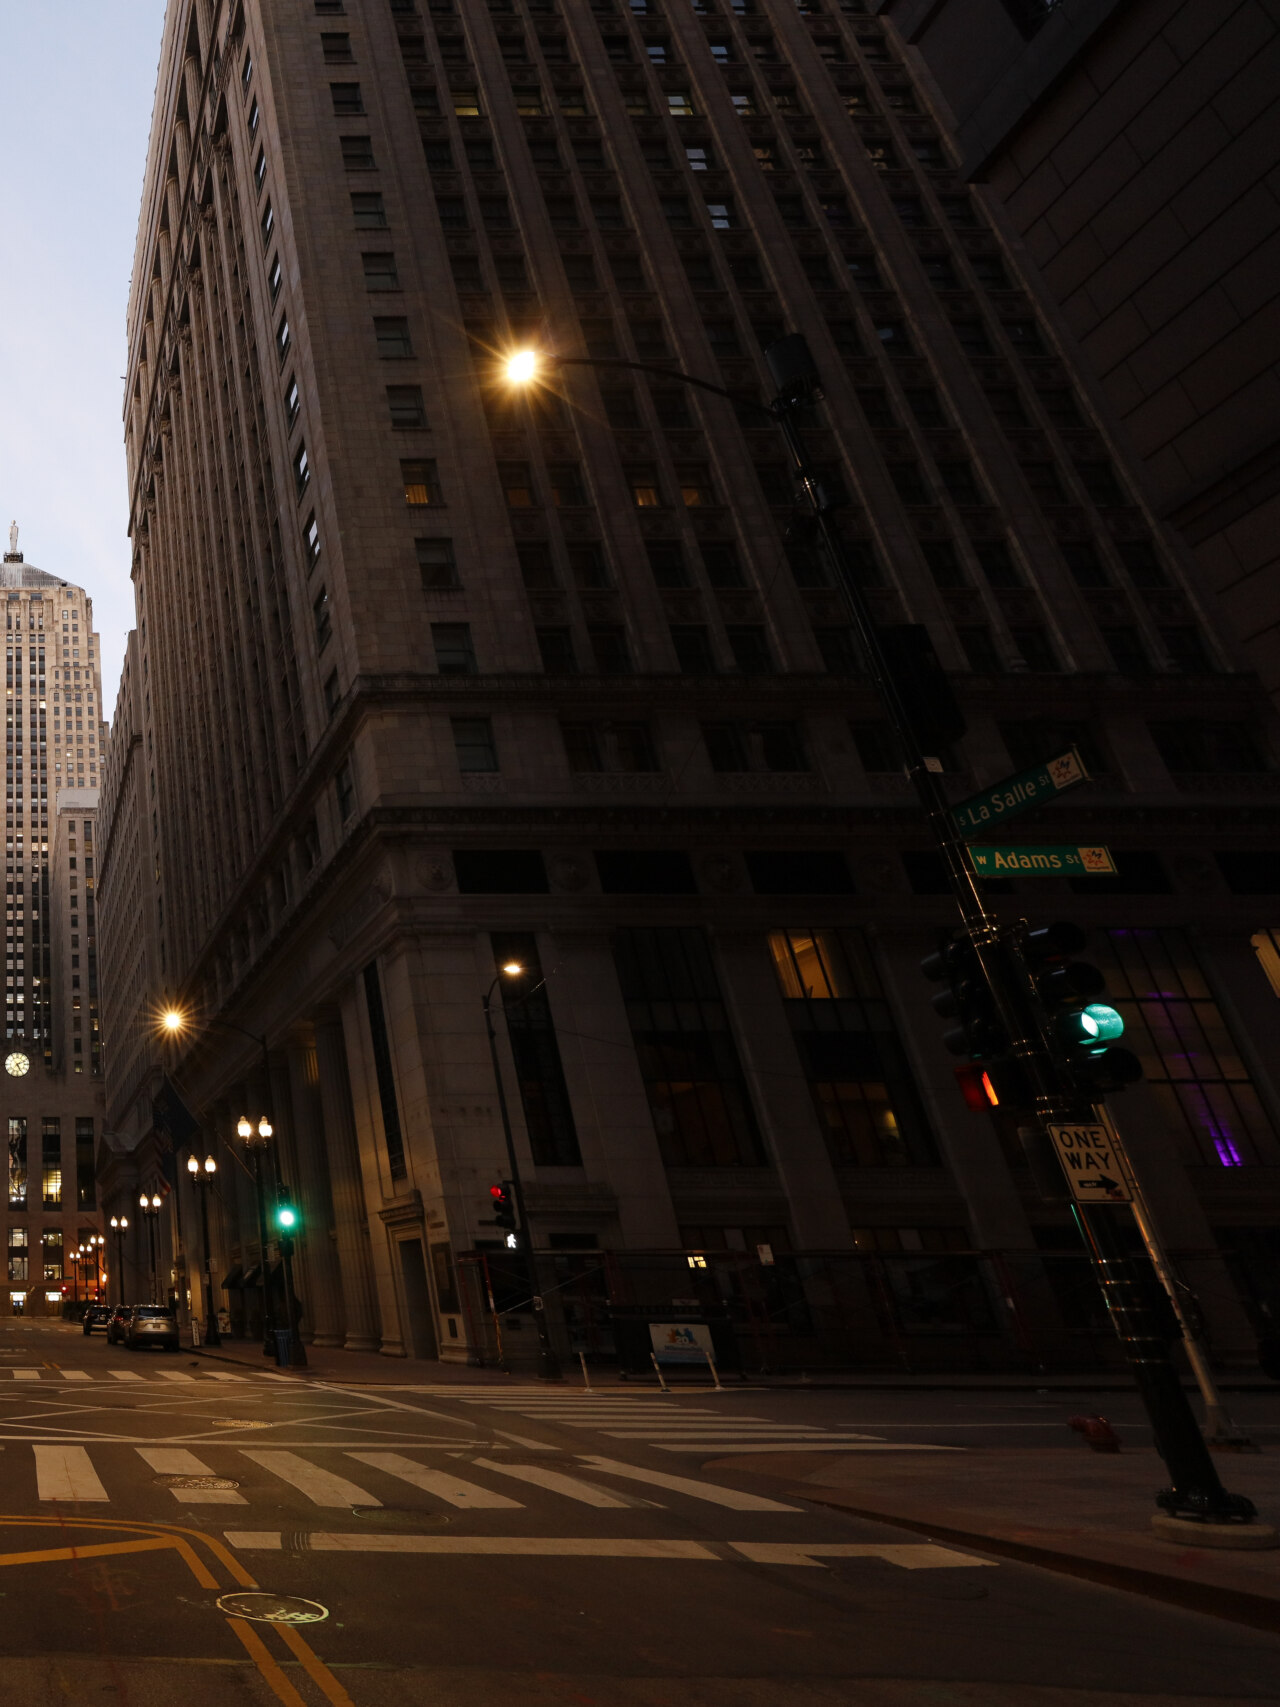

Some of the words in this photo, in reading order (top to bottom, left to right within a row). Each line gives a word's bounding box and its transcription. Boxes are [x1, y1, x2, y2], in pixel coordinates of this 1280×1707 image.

[959, 815, 966, 826] S
[967, 805, 991, 825] La
[991, 781, 1037, 813] Salle
[1038, 773, 1050, 787] St
[976, 855, 987, 865] W
[994, 851, 1063, 869] Adams
[1066, 854, 1080, 864] St
[1060, 1131, 1105, 1148] ONE
[1065, 1152, 1110, 1169] WAY
